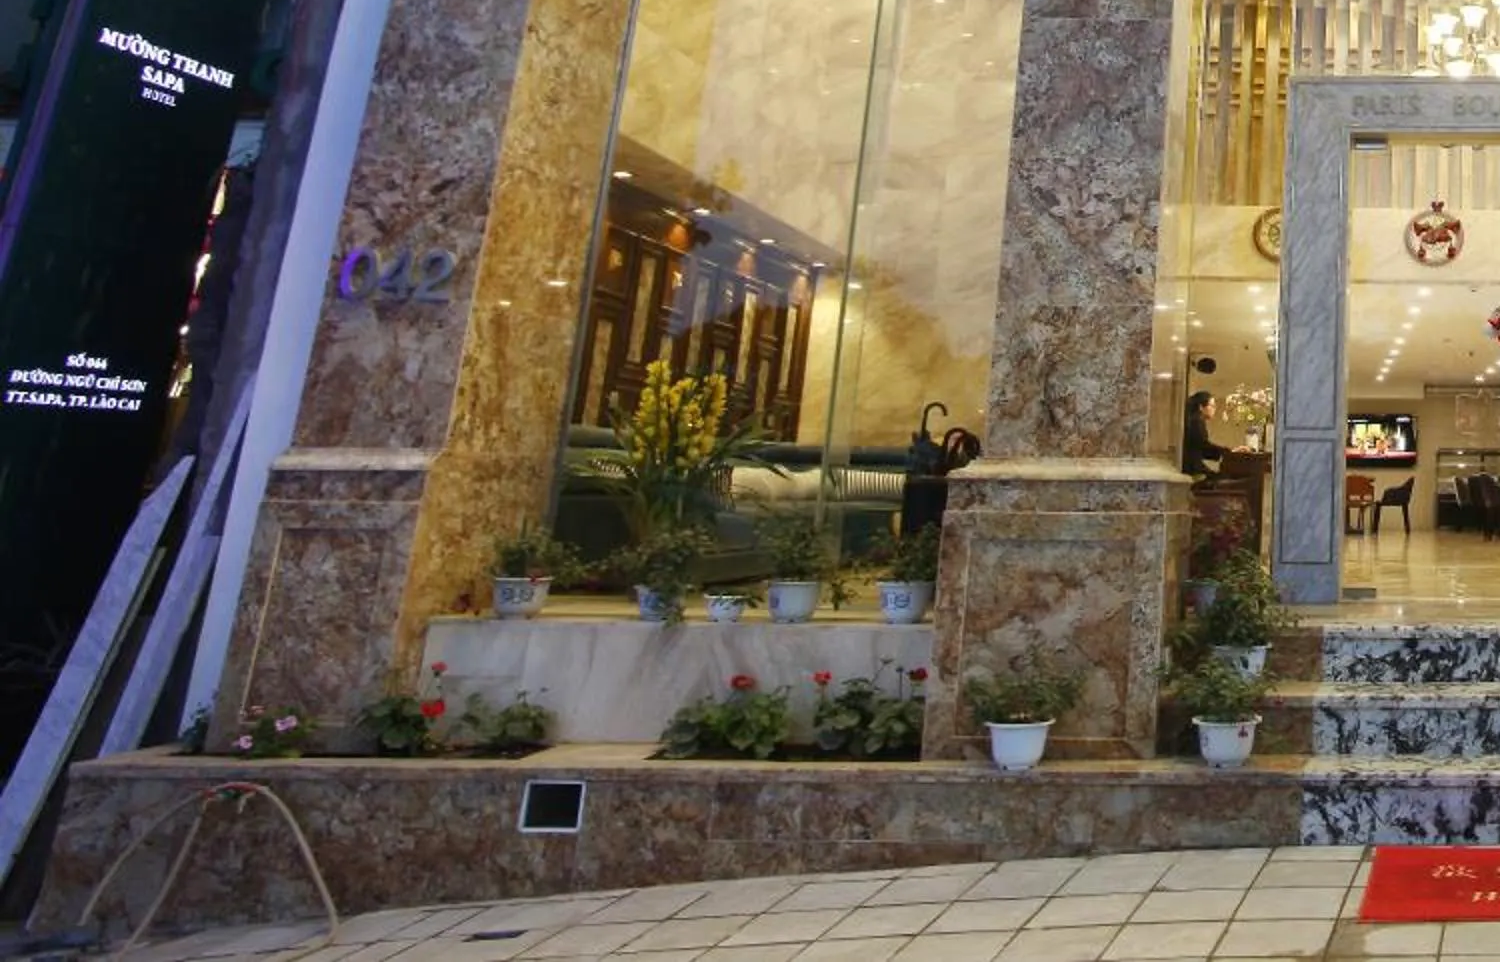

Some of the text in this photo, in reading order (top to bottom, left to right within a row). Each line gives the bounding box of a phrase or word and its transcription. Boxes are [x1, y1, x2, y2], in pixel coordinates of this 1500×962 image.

[141, 65, 185, 94] SAPA
[172, 53, 235, 89] THANH
[141, 87, 177, 107] HOTEL
[340, 245, 454, 301] 042
[117, 398, 141, 411] CAI
